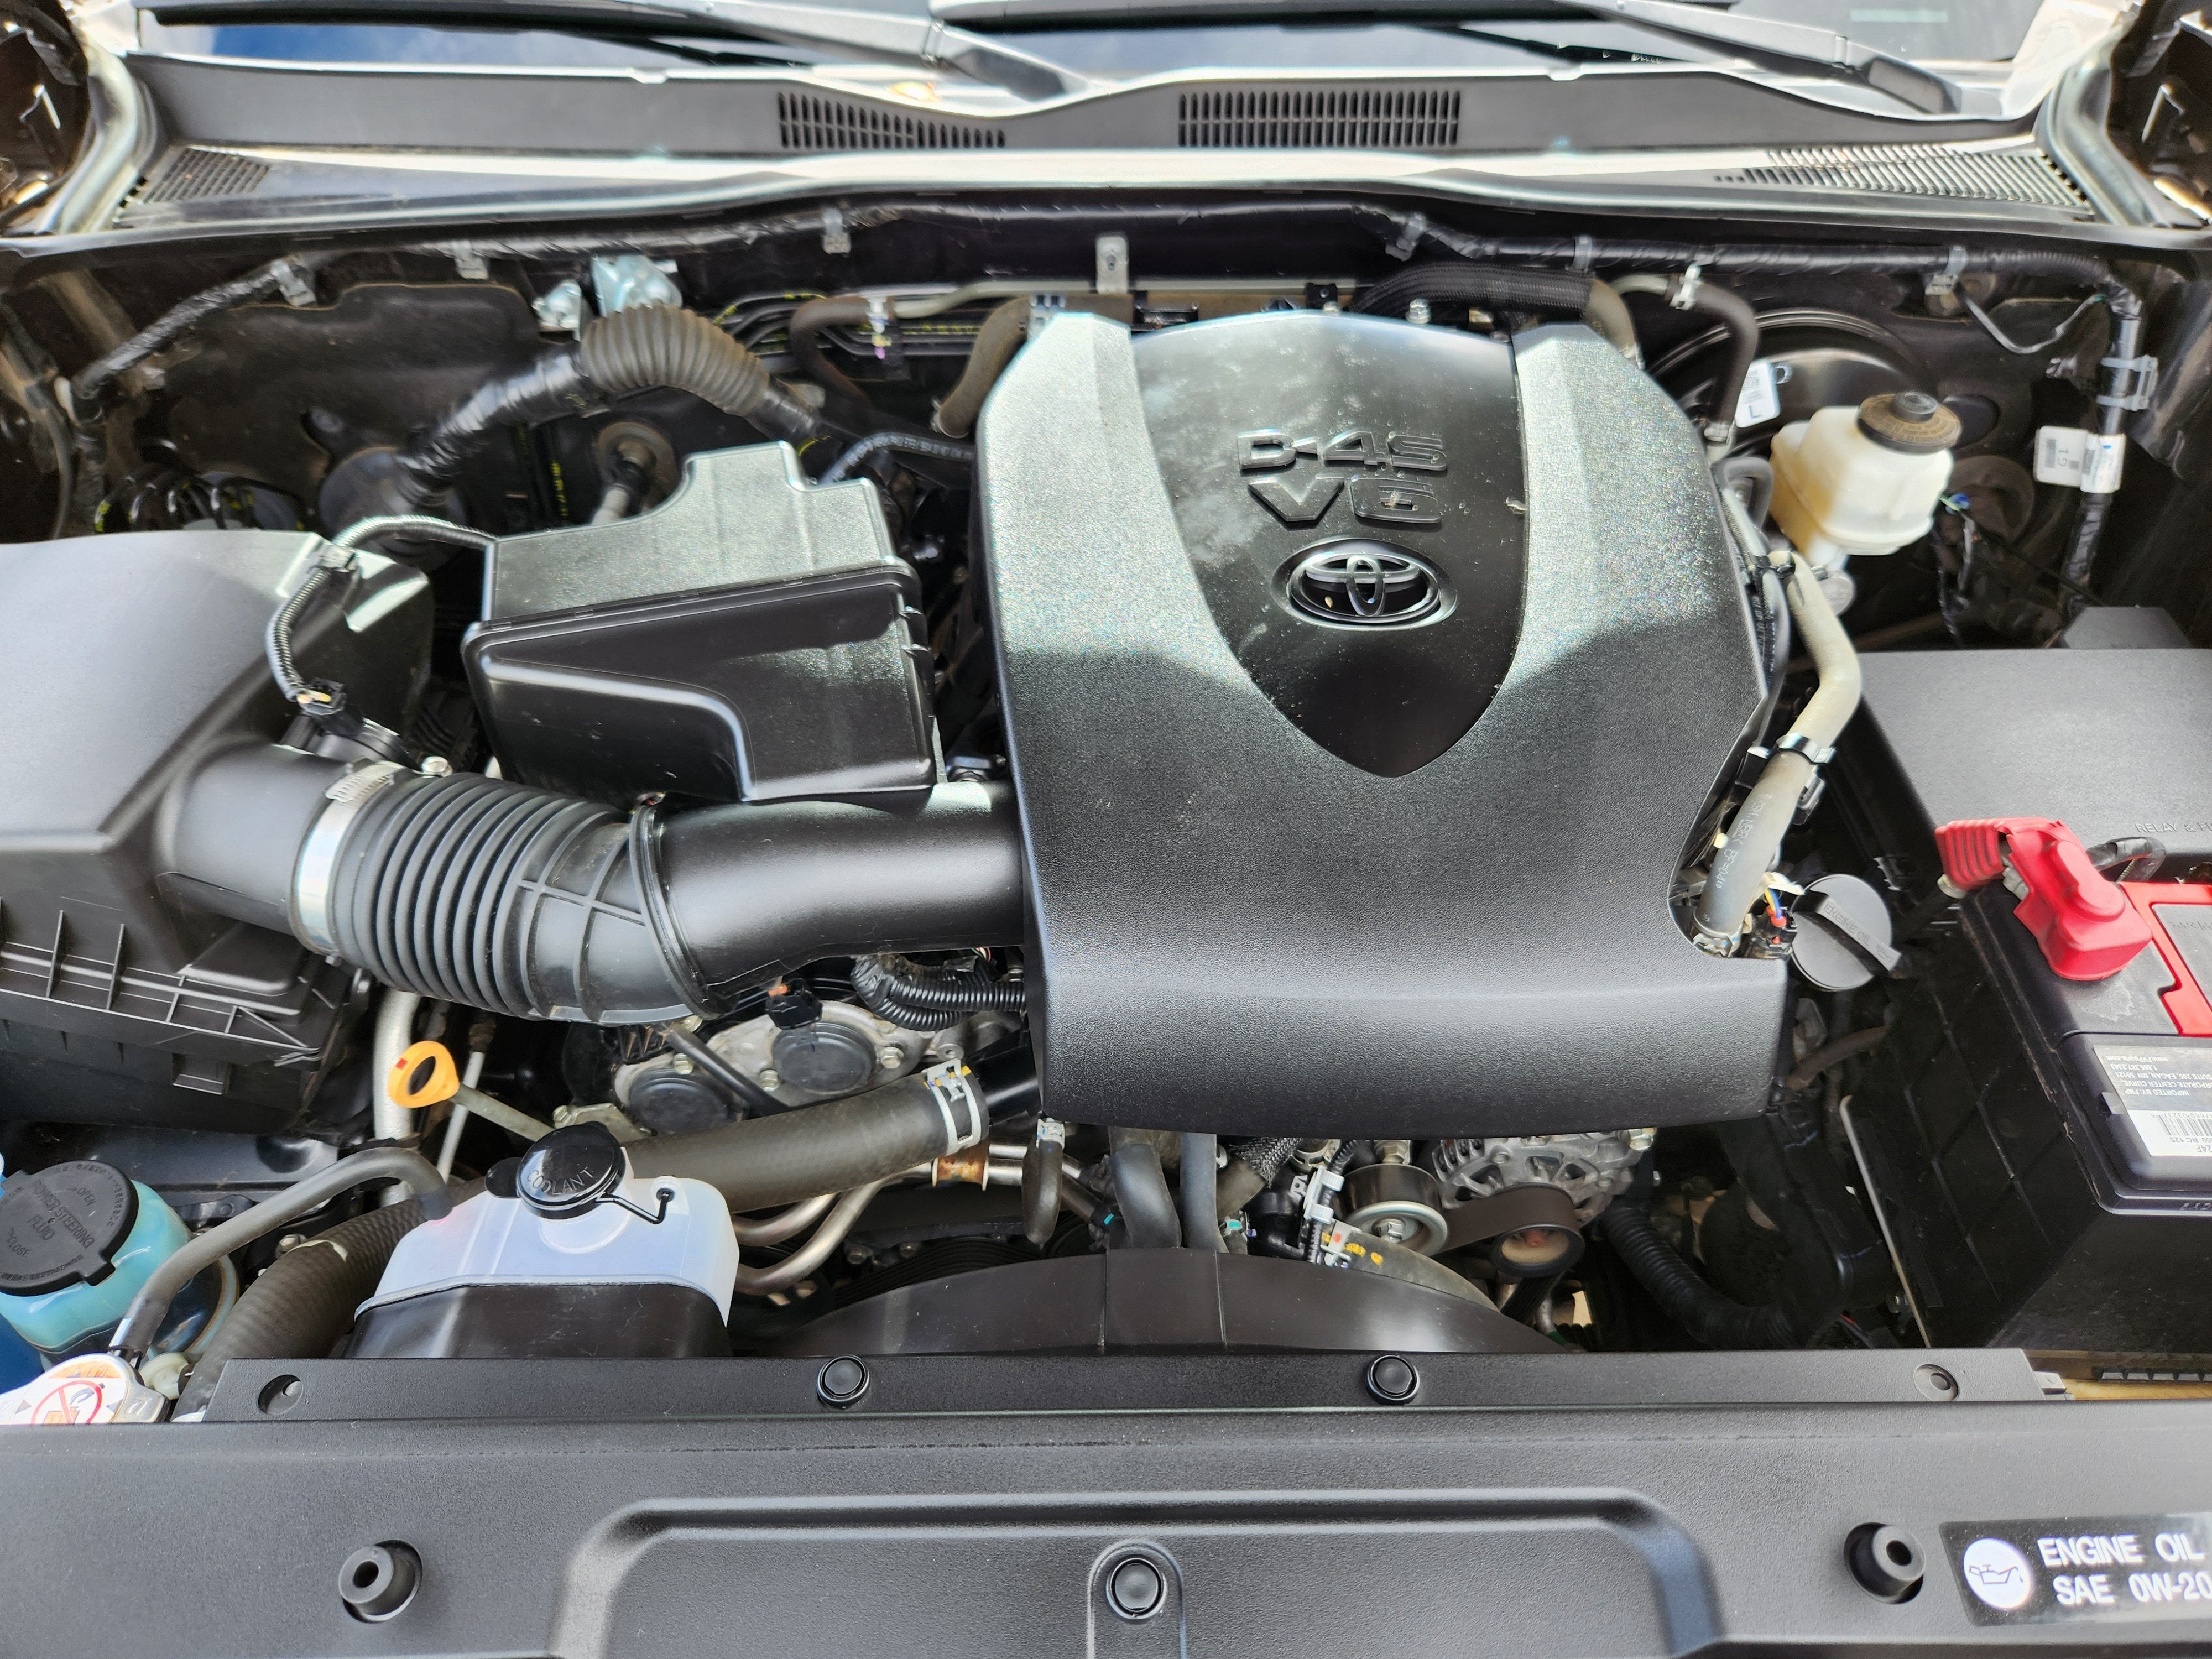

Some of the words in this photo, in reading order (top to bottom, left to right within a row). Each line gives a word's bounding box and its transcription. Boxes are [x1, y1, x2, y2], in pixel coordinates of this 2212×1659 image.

[1248, 474, 1441, 523] V6
[2133, 822, 2178, 833] RELAY
[2184, 822, 2196, 832] &
[1823, 902, 1858, 934] ENGINE
[1856, 930, 1871, 947] OIL
[77, 1187, 96, 1206] OPEN
[526, 1166, 595, 1196] COOLANT
[28, 1214, 55, 1240] FLUID
[34, 1179, 61, 1211] POWER
[55, 1206, 95, 1249] STEERING
[7, 1237, 32, 1258] CLOSE
[2037, 1533, 2145, 1567] ENGINE
[2154, 1532, 2205, 1563] OIL
[2052, 1574, 2115, 1605] SAE
[2127, 1571, 2212, 1603] 0W-20
